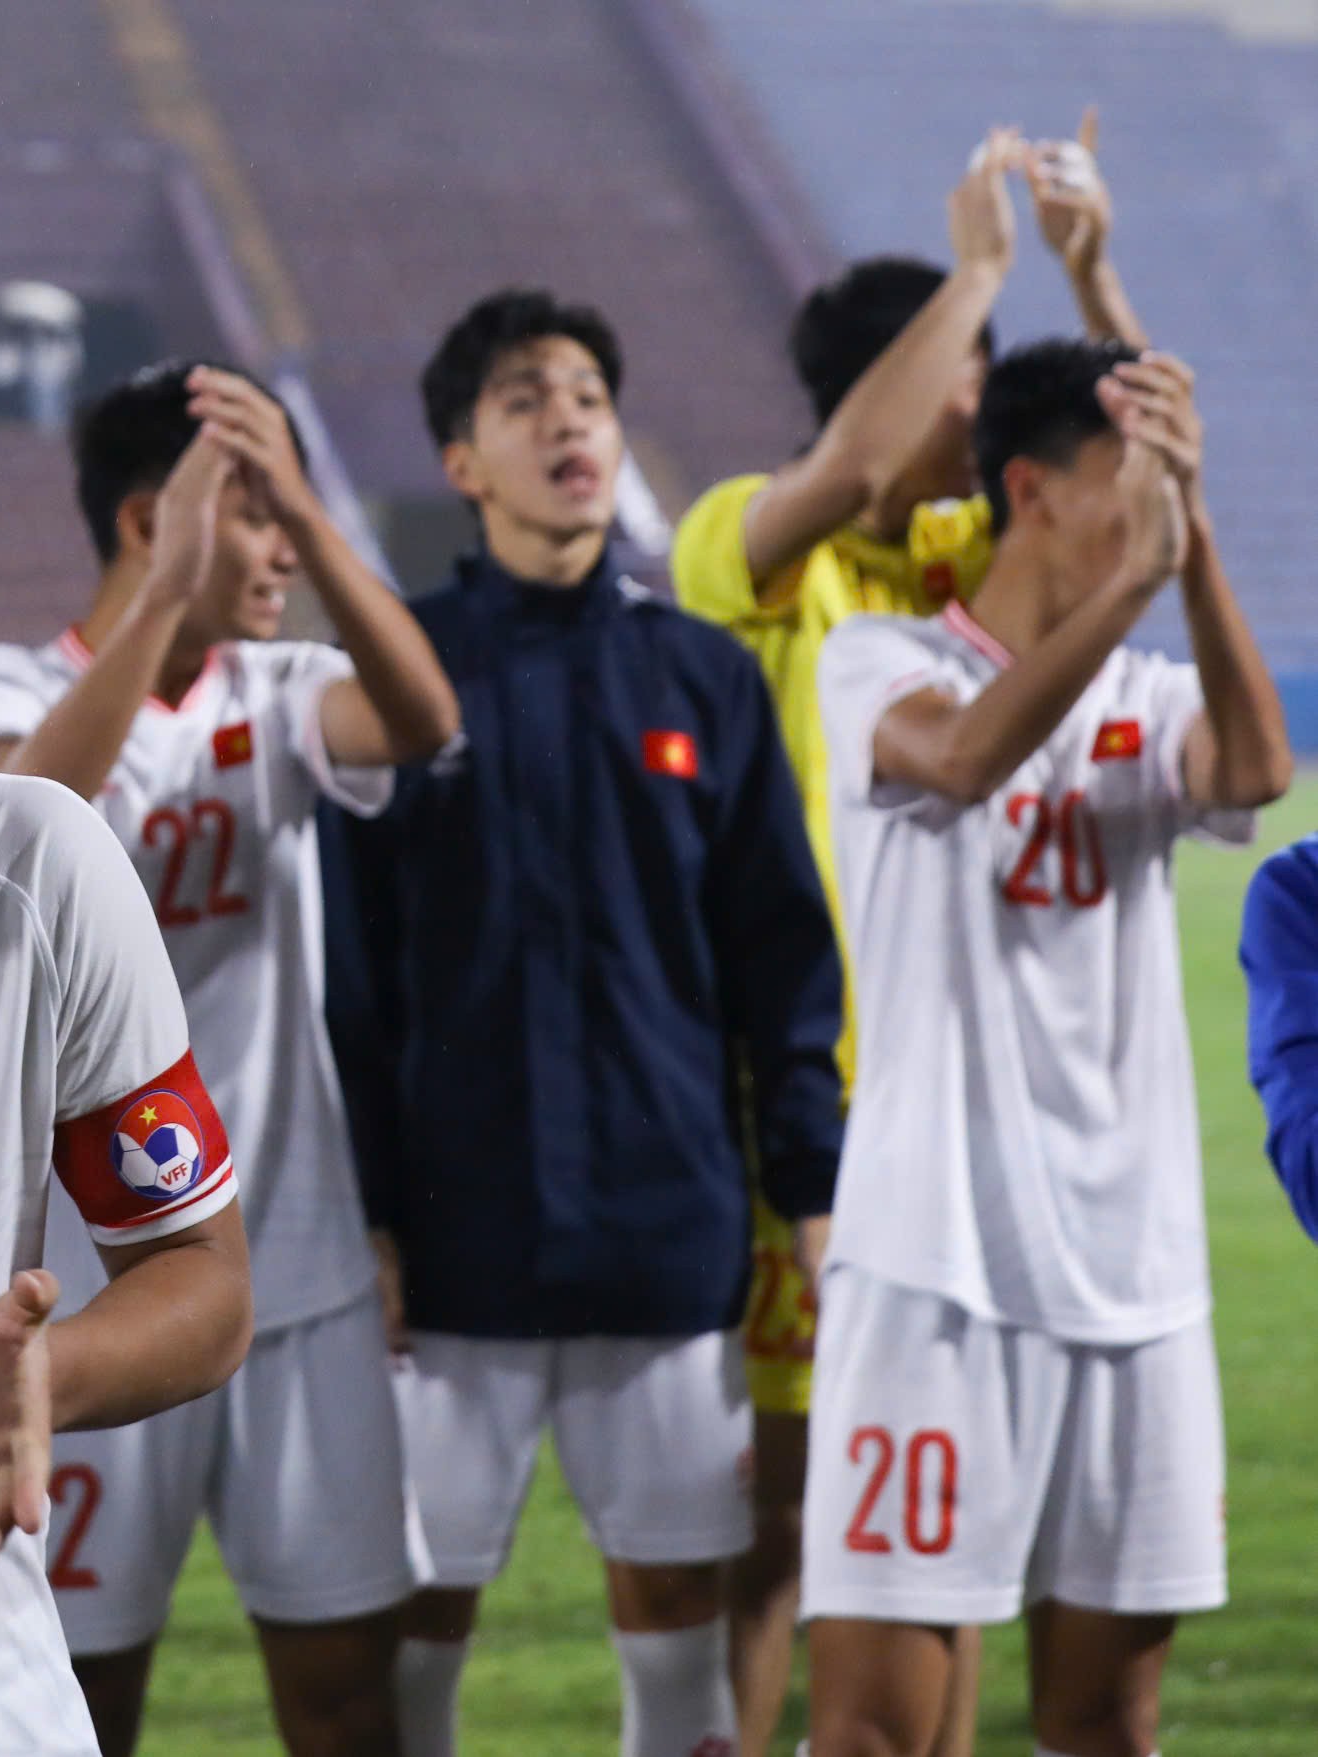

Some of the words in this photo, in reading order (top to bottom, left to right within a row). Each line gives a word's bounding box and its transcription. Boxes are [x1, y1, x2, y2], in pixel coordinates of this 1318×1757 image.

[141, 799, 251, 927] 22
[1003, 789, 1108, 909] 20
[160, 1163, 189, 1186] VFF
[843, 1424, 958, 1557] 20
